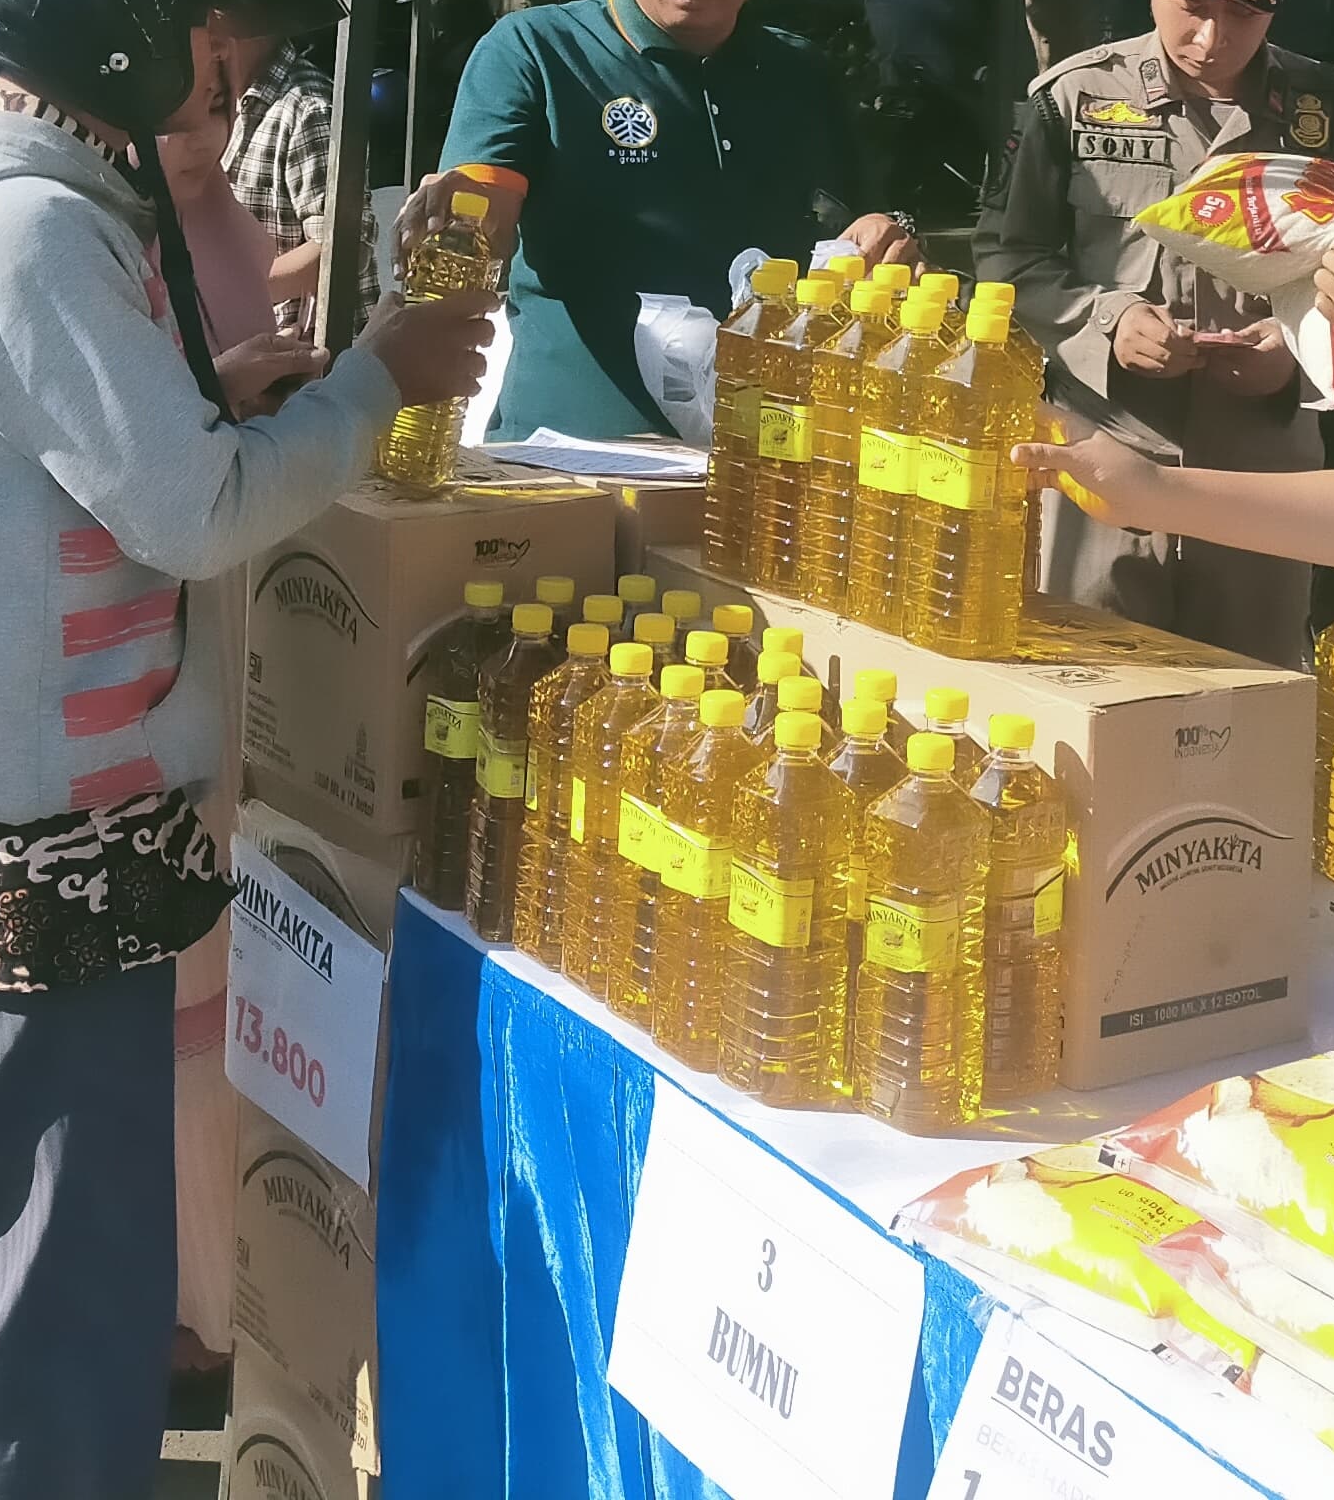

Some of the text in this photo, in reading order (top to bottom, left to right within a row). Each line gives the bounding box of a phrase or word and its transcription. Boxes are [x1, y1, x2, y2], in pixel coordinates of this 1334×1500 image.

[1085, 134, 1155, 157] SONY
[274, 576, 358, 645] MINYAKITA
[1135, 833, 1263, 896] MINYAKITA
[236, 866, 334, 979] MINYAKITA
[235, 996, 326, 1108] 13.800
[1129, 1013, 1144, 1028] ISI
[757, 1237, 777, 1293] 3
[706, 1305, 799, 1420] BUMNU
[996, 1355, 1116, 1467] BERAS
